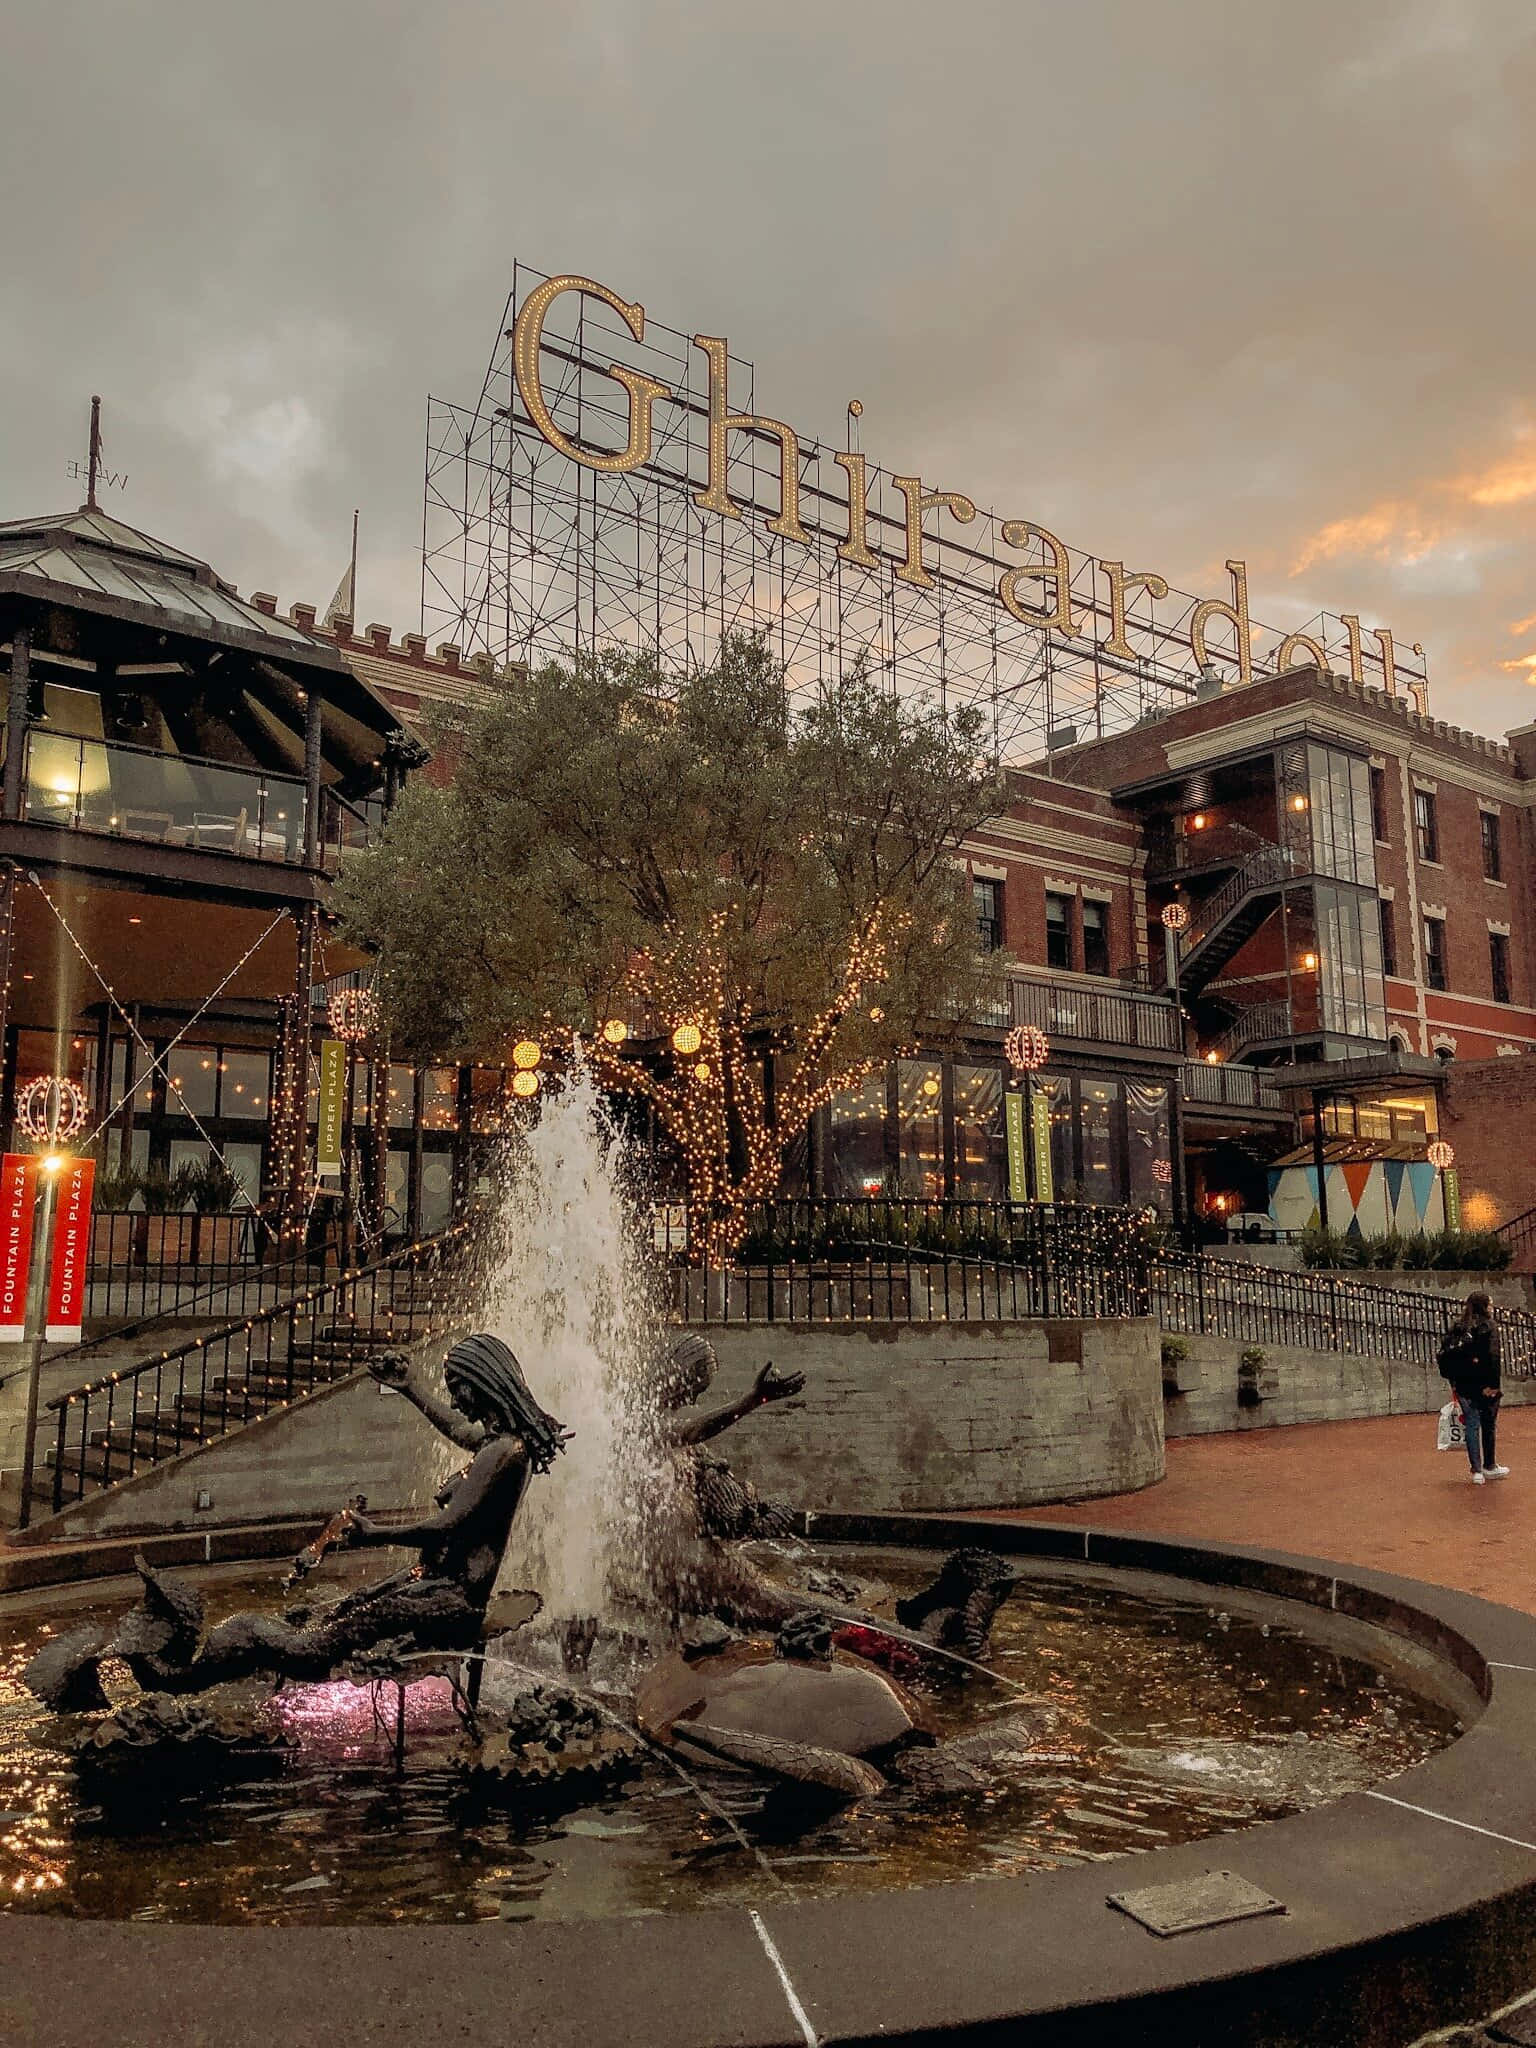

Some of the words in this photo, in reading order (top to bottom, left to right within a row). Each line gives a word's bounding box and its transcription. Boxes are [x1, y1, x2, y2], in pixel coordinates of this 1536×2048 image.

[328, 1049, 337, 1096] PLAZA
[326, 1104, 336, 1153] UPPER
[1011, 1102, 1019, 1143] PLAZA
[11, 1165, 25, 1218] PLAZA
[1014, 1149, 1022, 1193] UPPER
[61, 1230, 77, 1314] FOUNTAIN
[69, 1169, 82, 1221] PLAZA
[3, 1227, 20, 1314] FOUNTAIN
[1450, 1414, 1459, 1428] I
